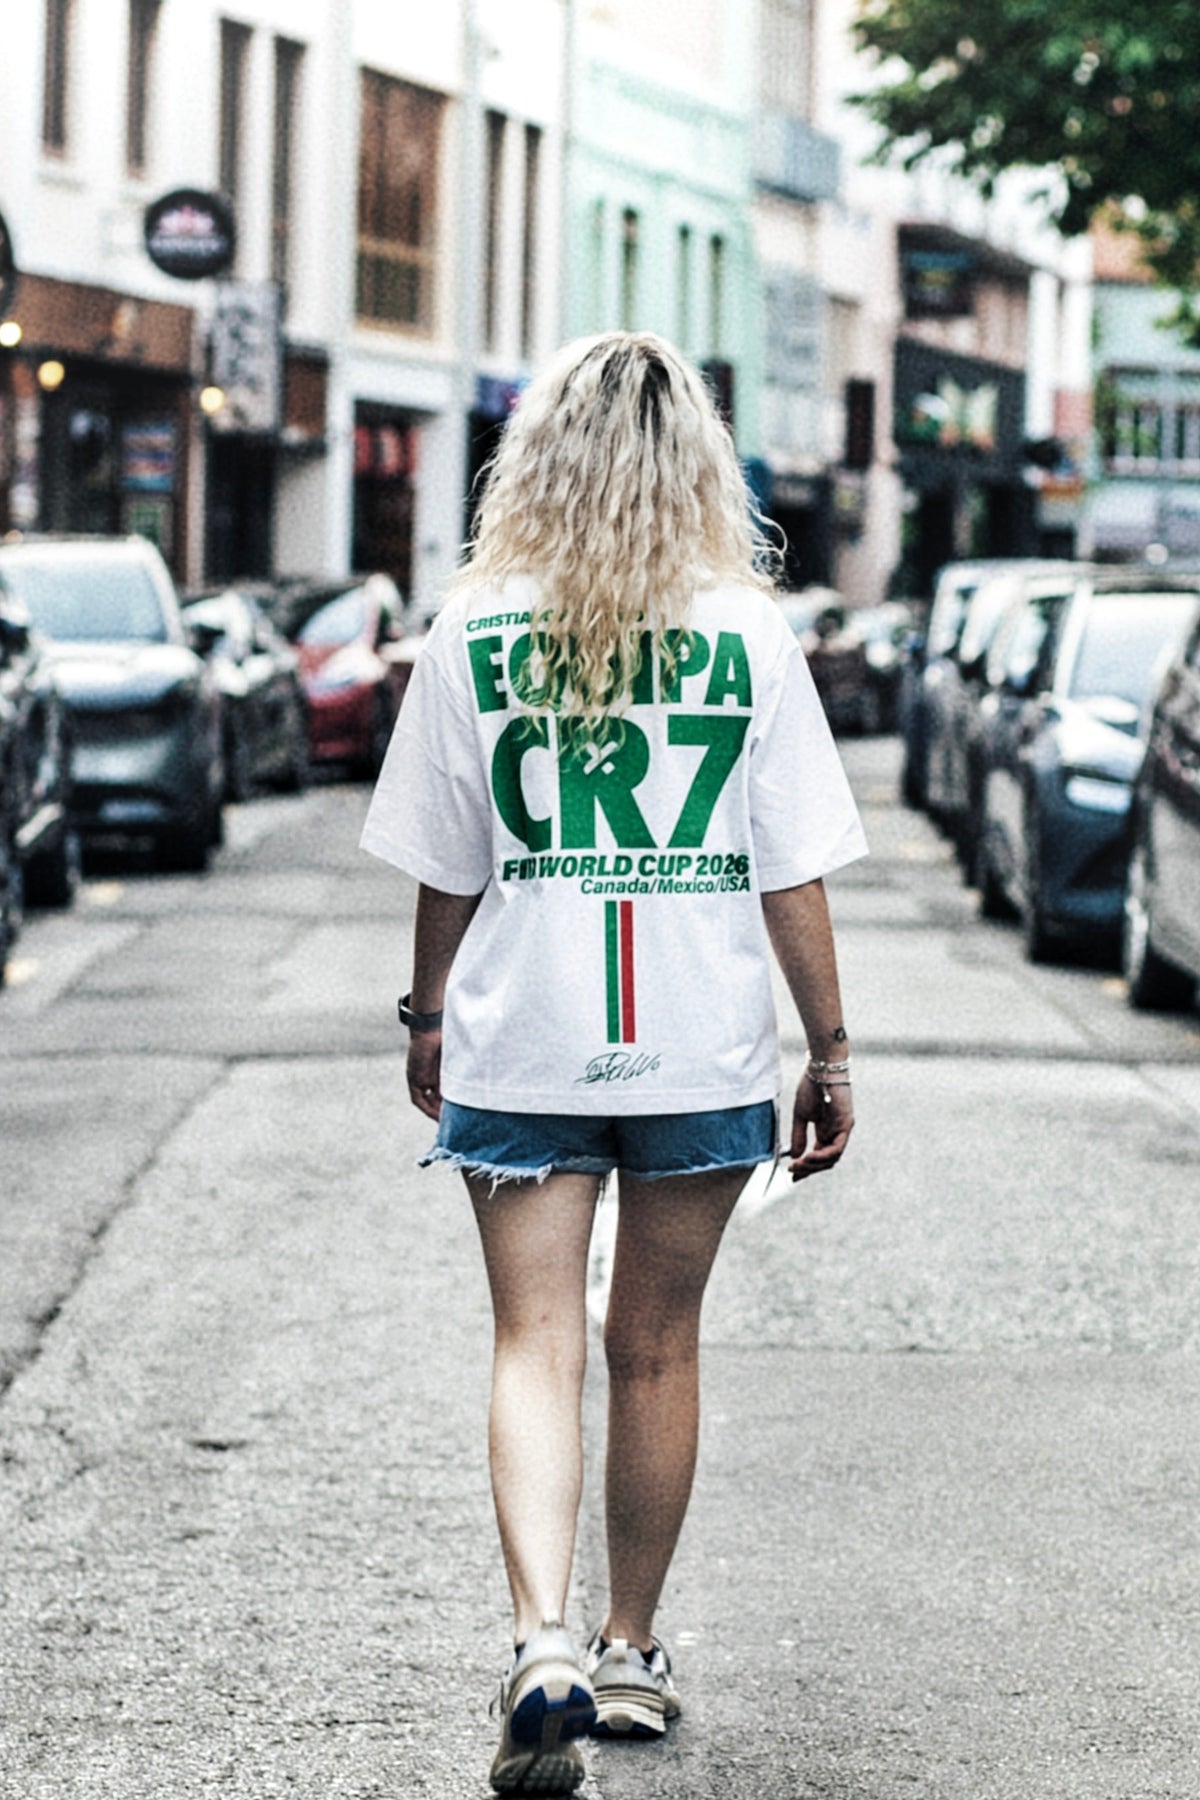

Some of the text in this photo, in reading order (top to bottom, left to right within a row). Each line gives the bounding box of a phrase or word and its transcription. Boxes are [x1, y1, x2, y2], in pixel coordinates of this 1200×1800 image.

[491, 714, 752, 852] CR7
[538, 855, 633, 878] WORLD
[638, 854, 692, 876] CUP
[695, 853, 750, 876] 2026
[580, 876, 751, 894] Canada/Mexico/USA
